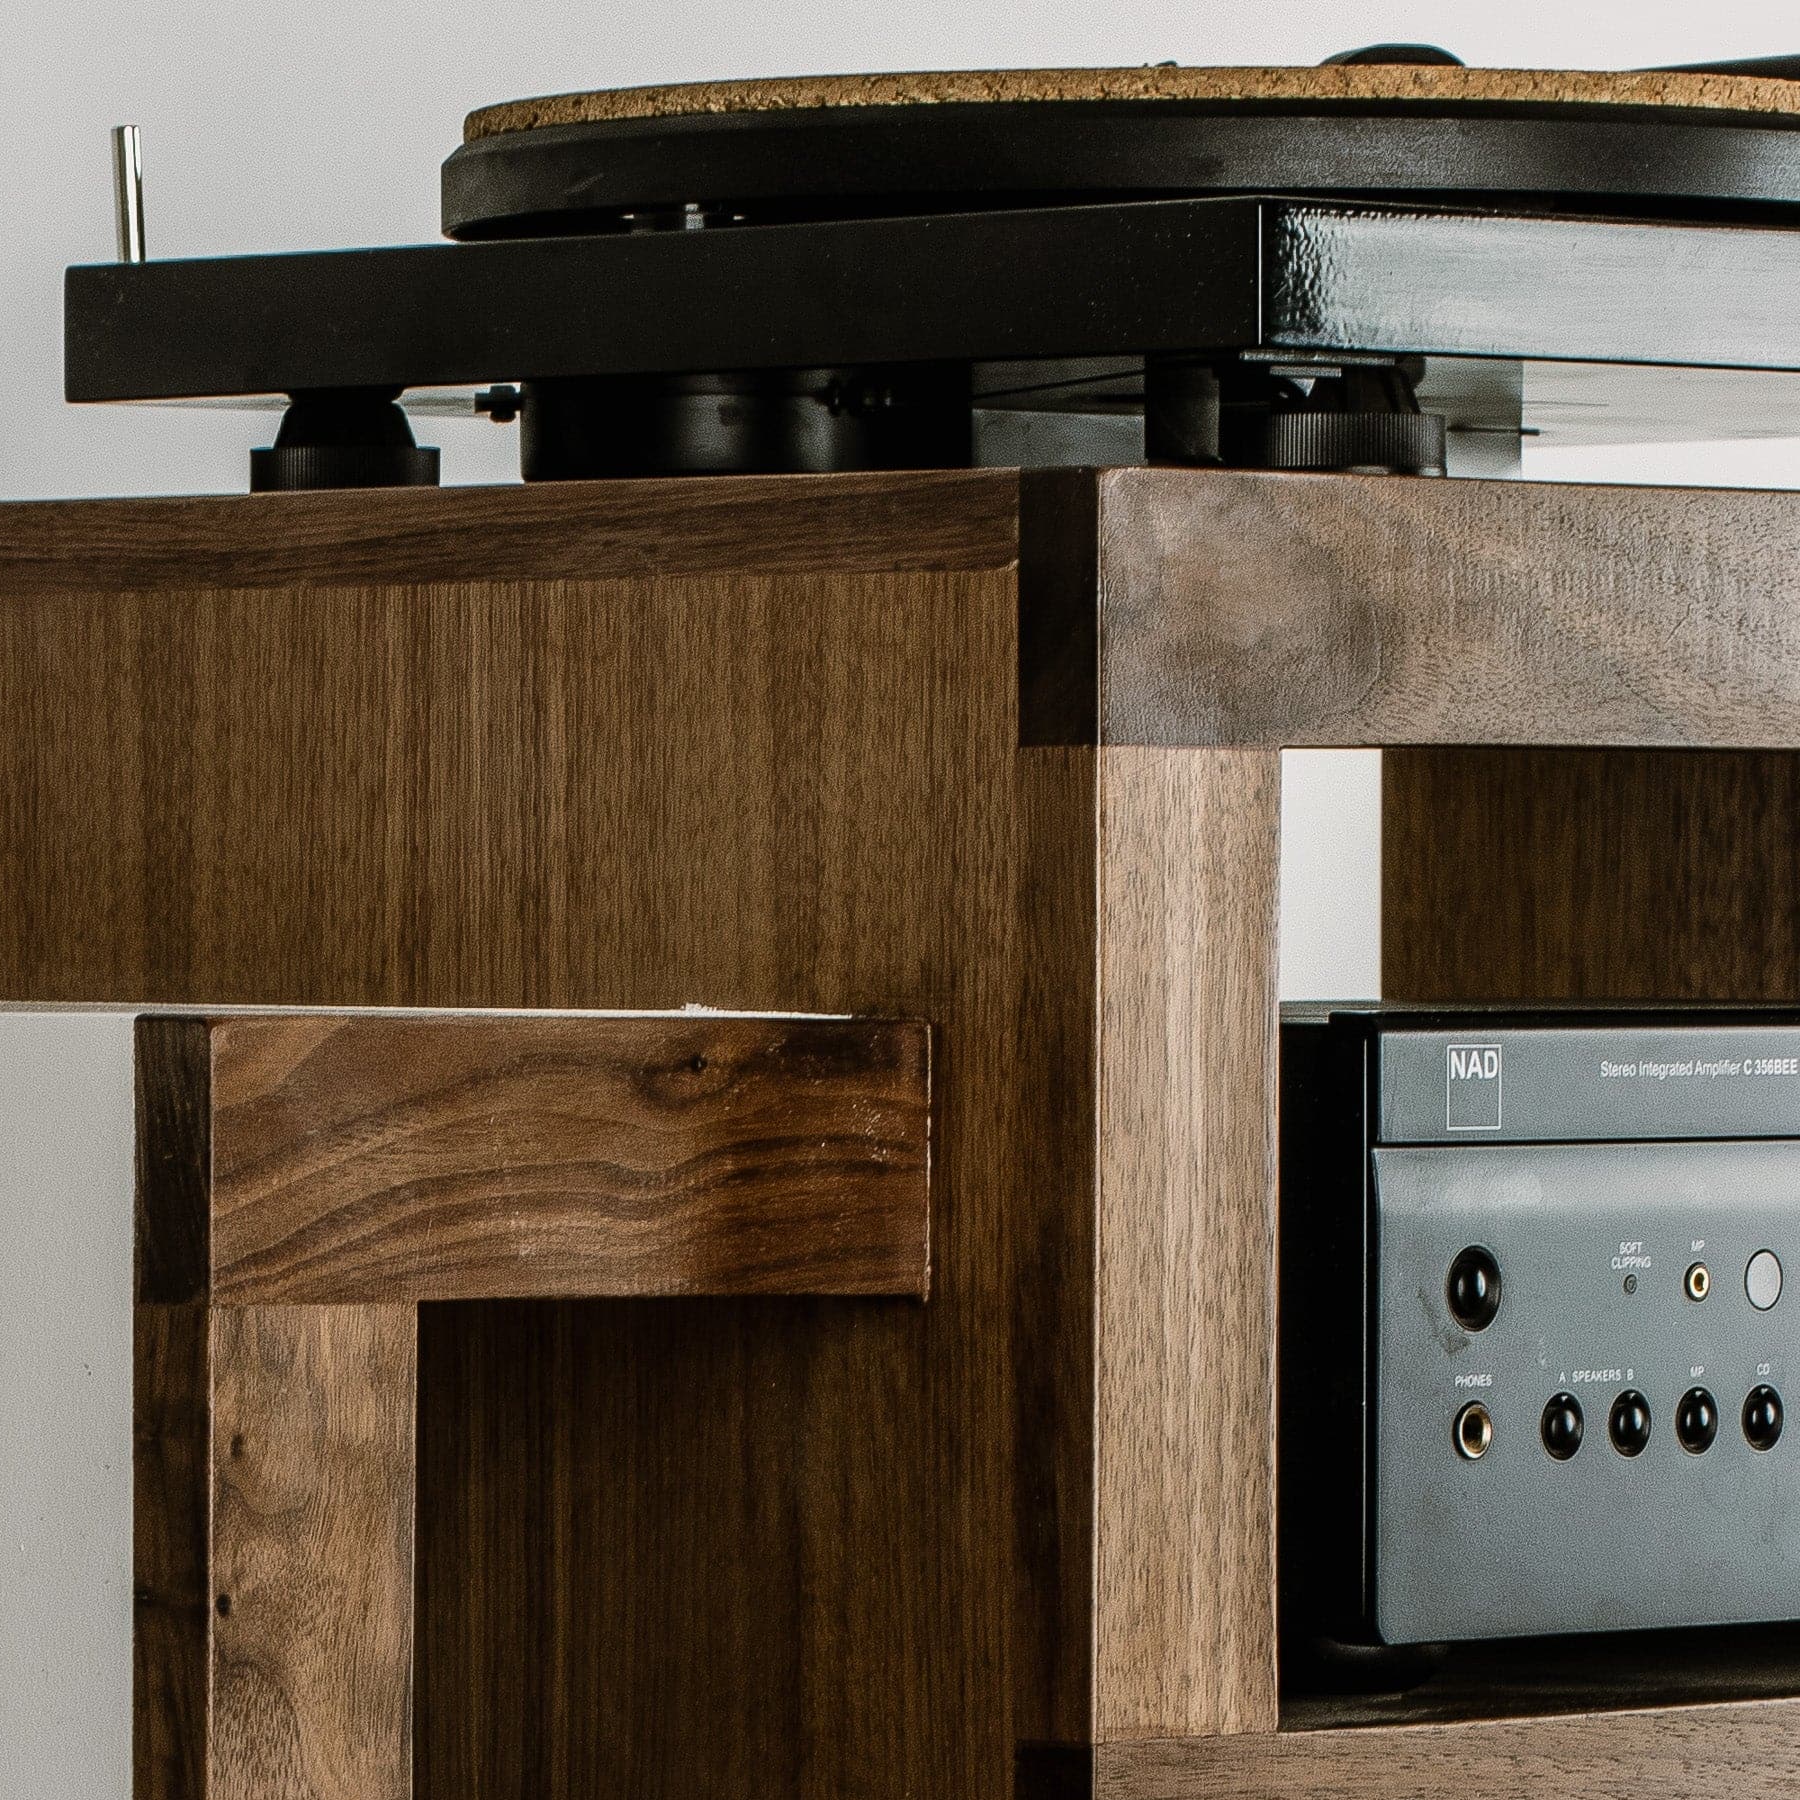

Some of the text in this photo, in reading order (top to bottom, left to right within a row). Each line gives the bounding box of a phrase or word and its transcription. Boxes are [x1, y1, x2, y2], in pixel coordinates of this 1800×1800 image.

[1450, 1050, 1499, 1080] NAD
[1600, 1058, 1798, 1080] Stereo Integrated Amplifier C 356BEE
[1619, 1241, 1643, 1255] SOFT
[1611, 1256, 1651, 1269] CLIPPING
[1455, 1374, 1493, 1388] PHONES
[1559, 1369, 1634, 1383] A SPEAKERS B
